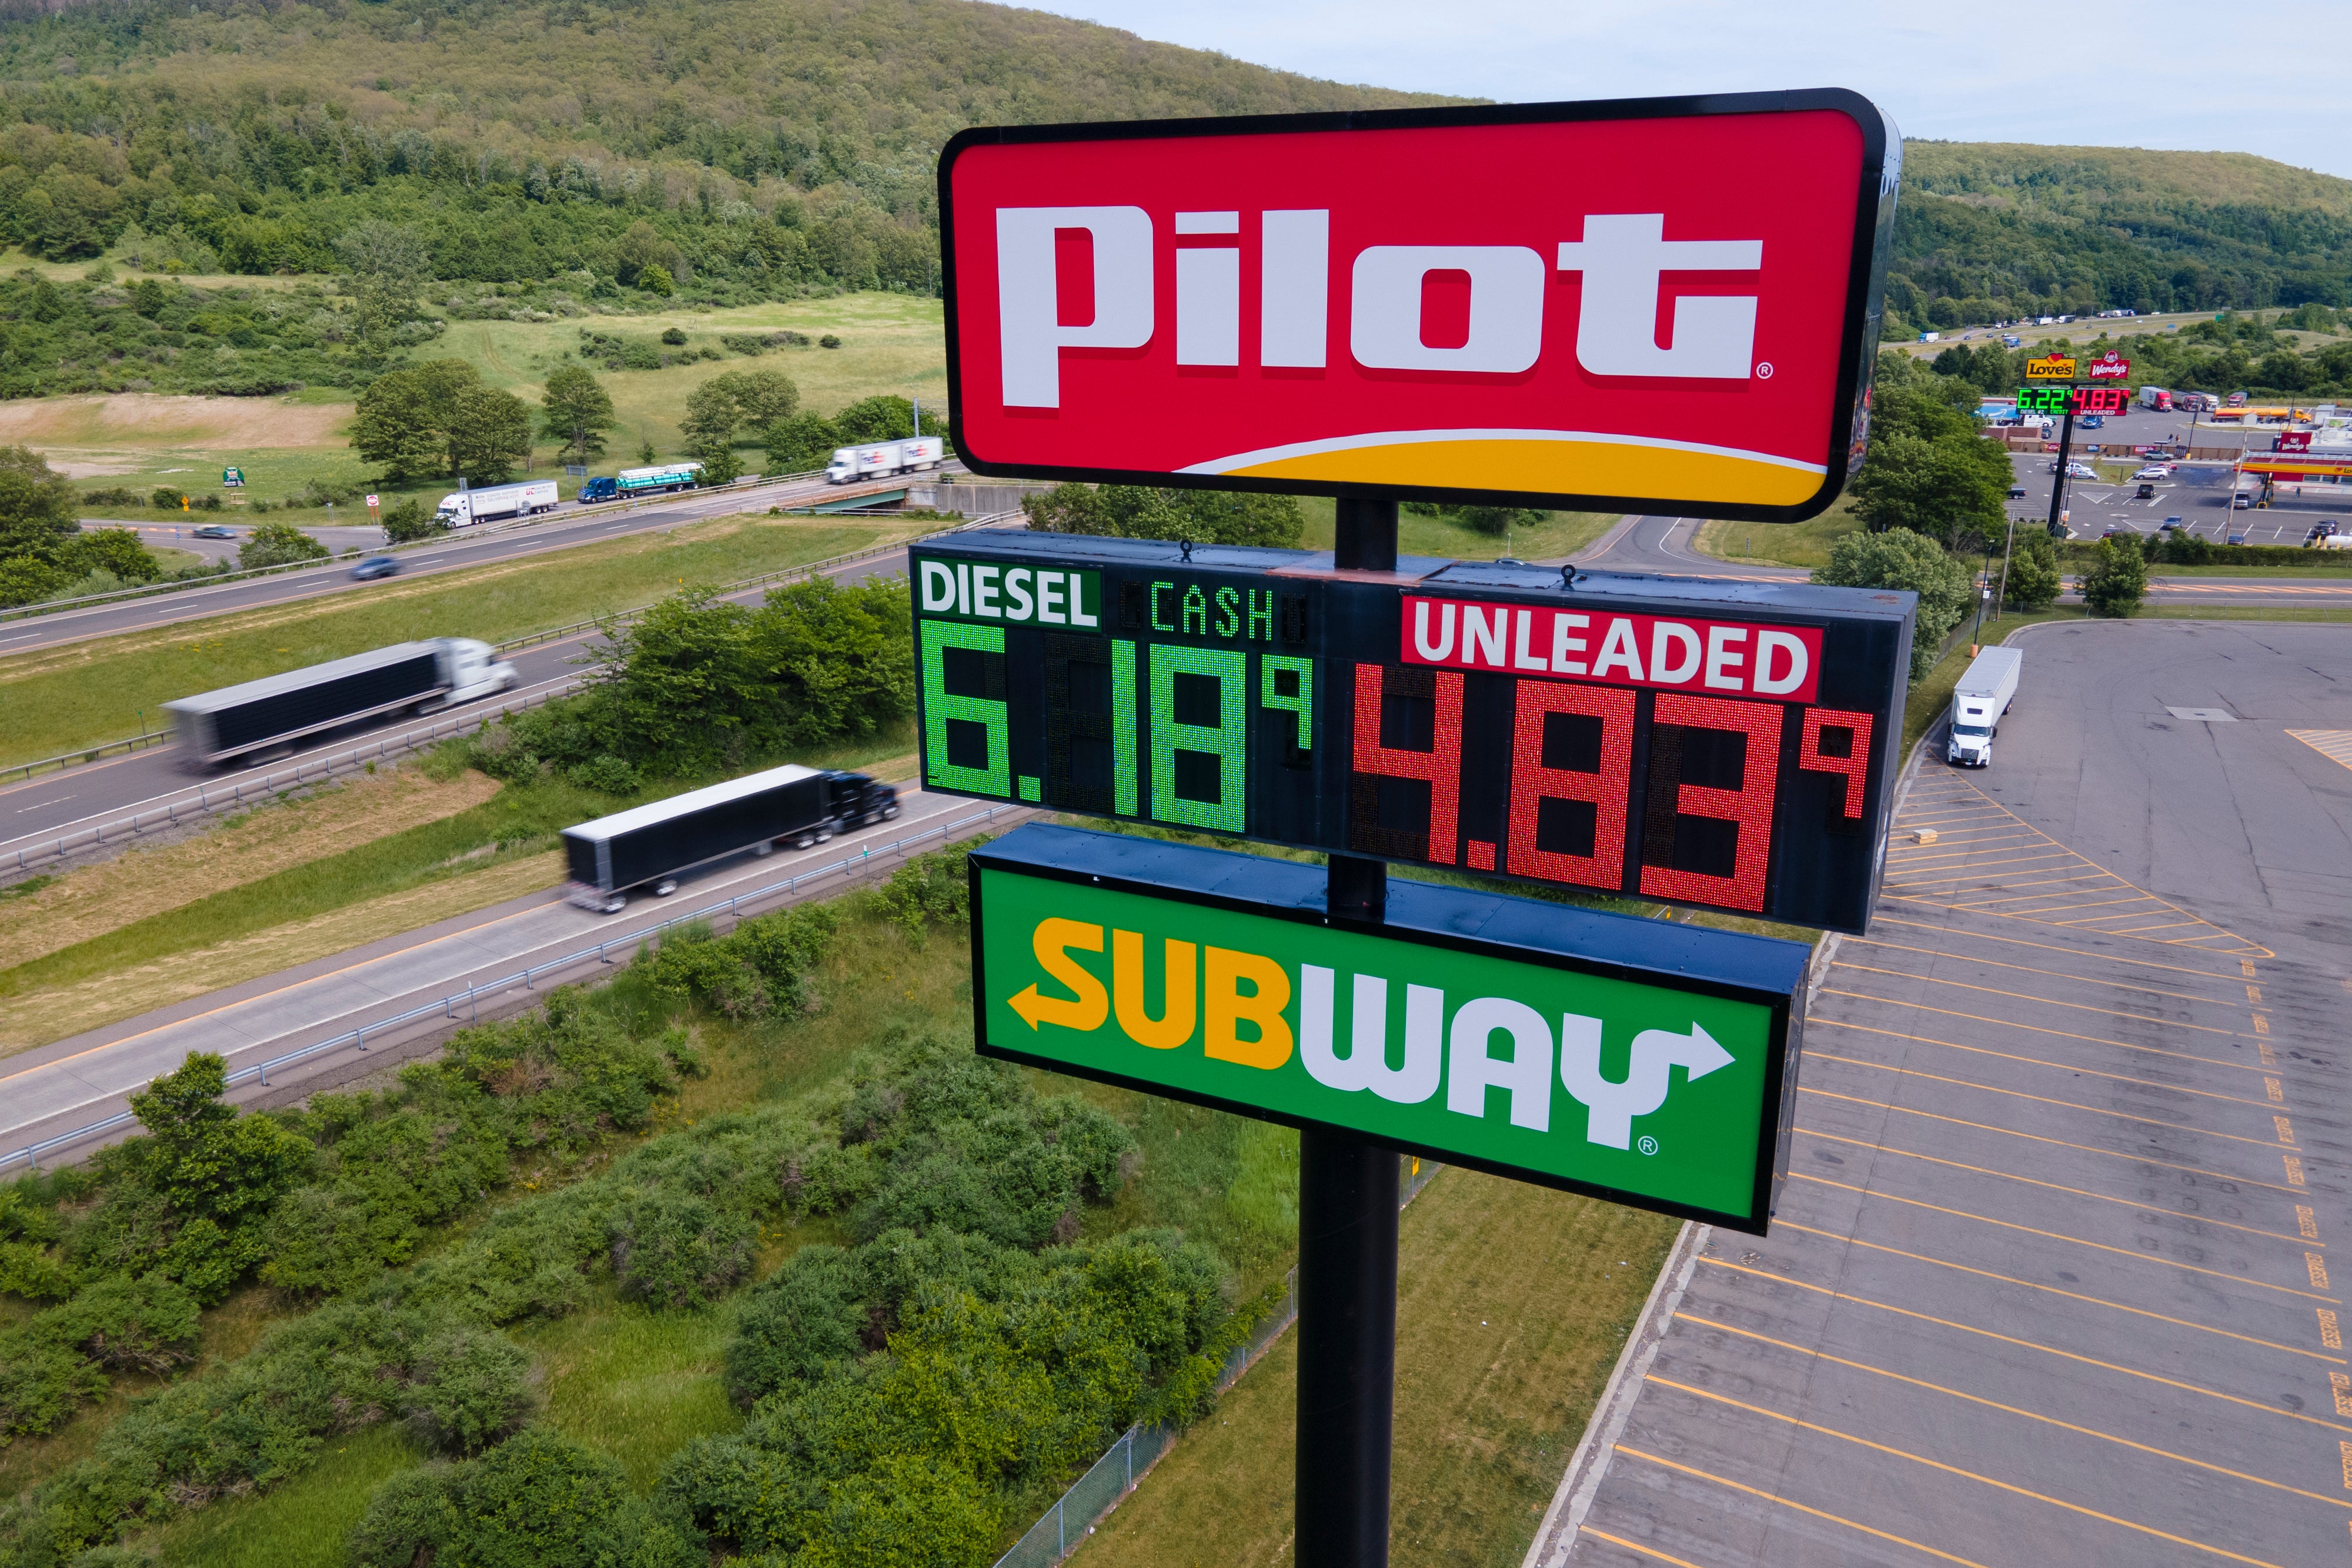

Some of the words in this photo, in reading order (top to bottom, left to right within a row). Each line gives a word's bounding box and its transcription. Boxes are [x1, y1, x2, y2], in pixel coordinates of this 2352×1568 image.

[995, 205, 1763, 407] Pilot
[2092, 363, 2127, 376] Wendy's
[2017, 389, 2065, 409] 6.22
[2067, 390, 2073, 398] 9
[2072, 390, 2120, 409] 4.83
[2122, 390, 2129, 399] 9
[920, 561, 1098, 627] DIESEL
[1151, 581, 1272, 641] CASH
[1414, 601, 1808, 695] UNLEADED
[920, 619, 1246, 833] 6.18
[1262, 654, 1313, 750] 9
[1352, 663, 1784, 912] 4.83
[1799, 708, 1874, 819] 9
[1007, 917, 1736, 1151] SUBWAY
[2282, 1155, 2305, 1186] RESERVED
[2296, 1205, 2318, 1239] RESERVED
[2304, 1252, 2330, 1289] RESERVED
[2316, 1308, 2342, 1350] RESERVED
